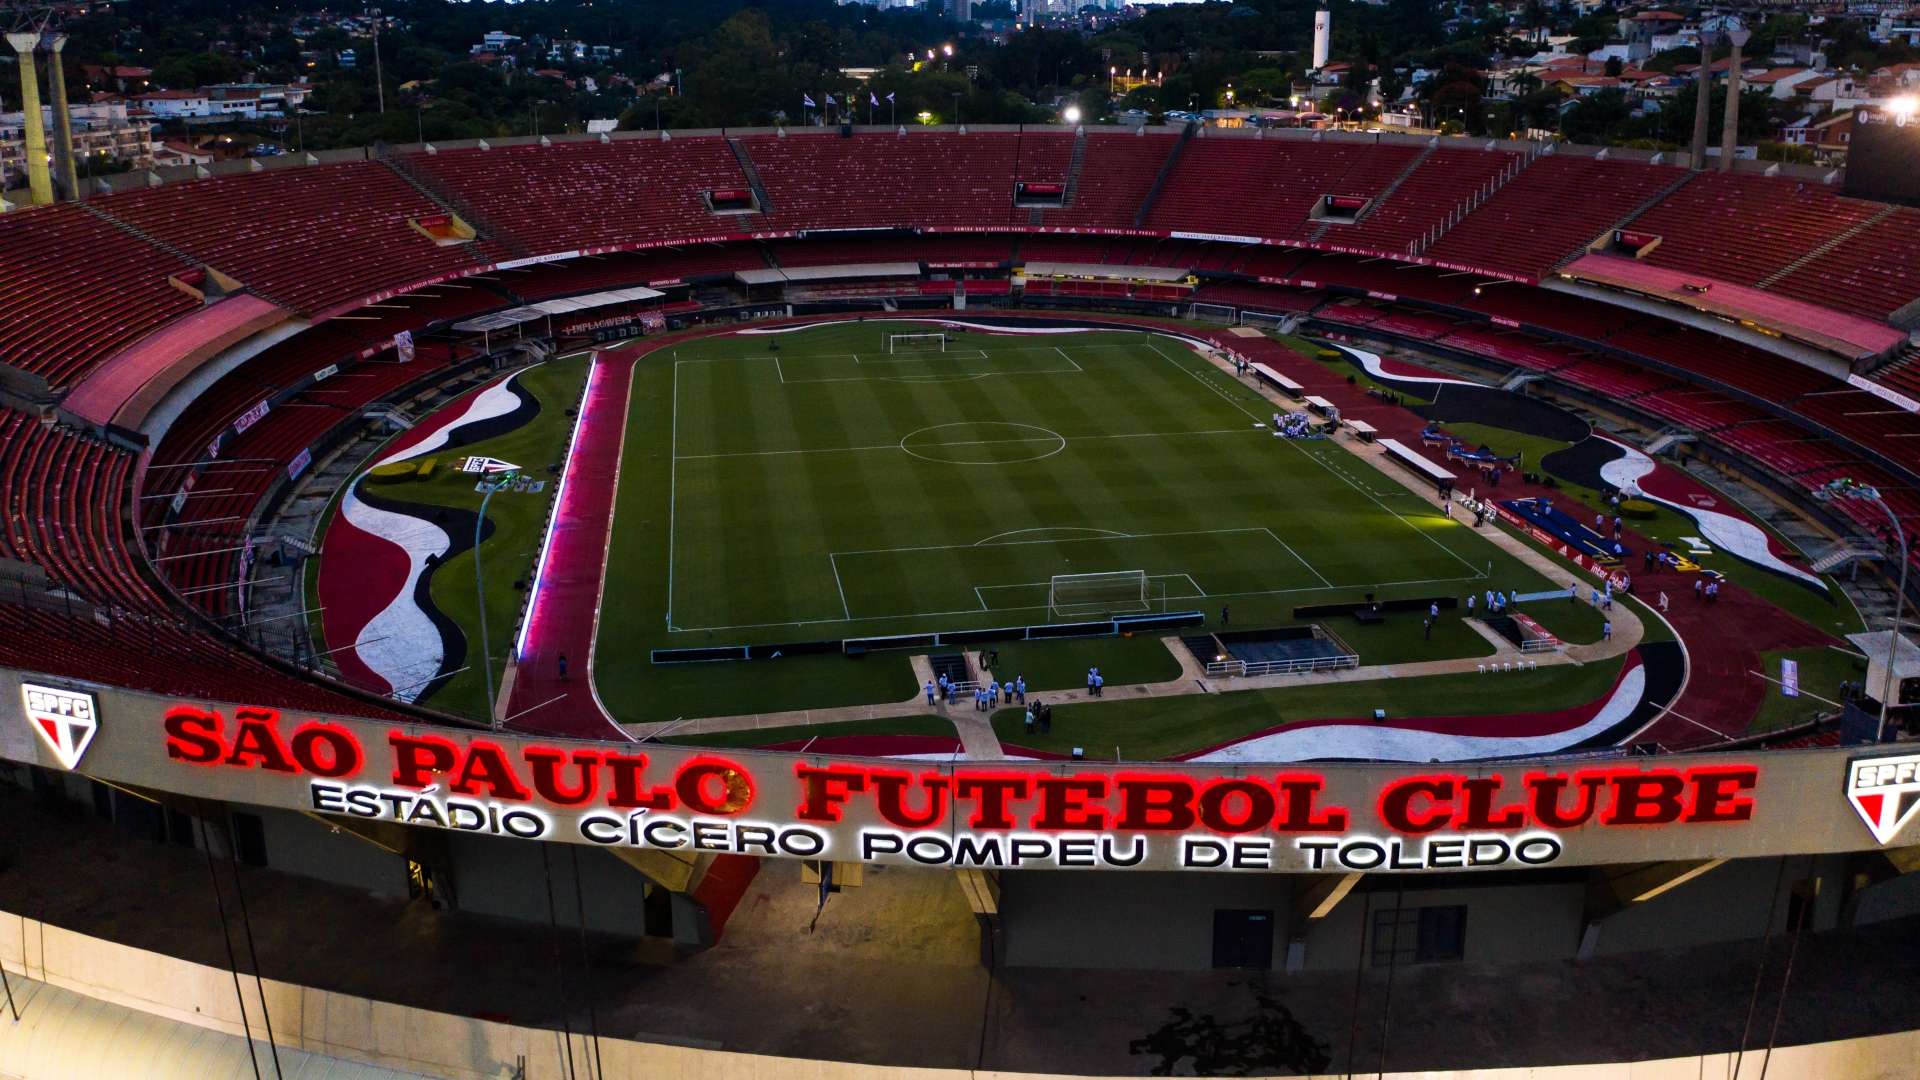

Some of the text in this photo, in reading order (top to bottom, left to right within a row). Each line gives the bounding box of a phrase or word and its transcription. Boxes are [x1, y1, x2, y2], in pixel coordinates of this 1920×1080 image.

[28, 689, 91, 720] SPFC
[163, 708, 1759, 835] SÃO PAULO FUTEBOL CLUBE
[309, 781, 1563, 871] ESTÁDIO CÍCERO POMPEU DE TOLEDO
